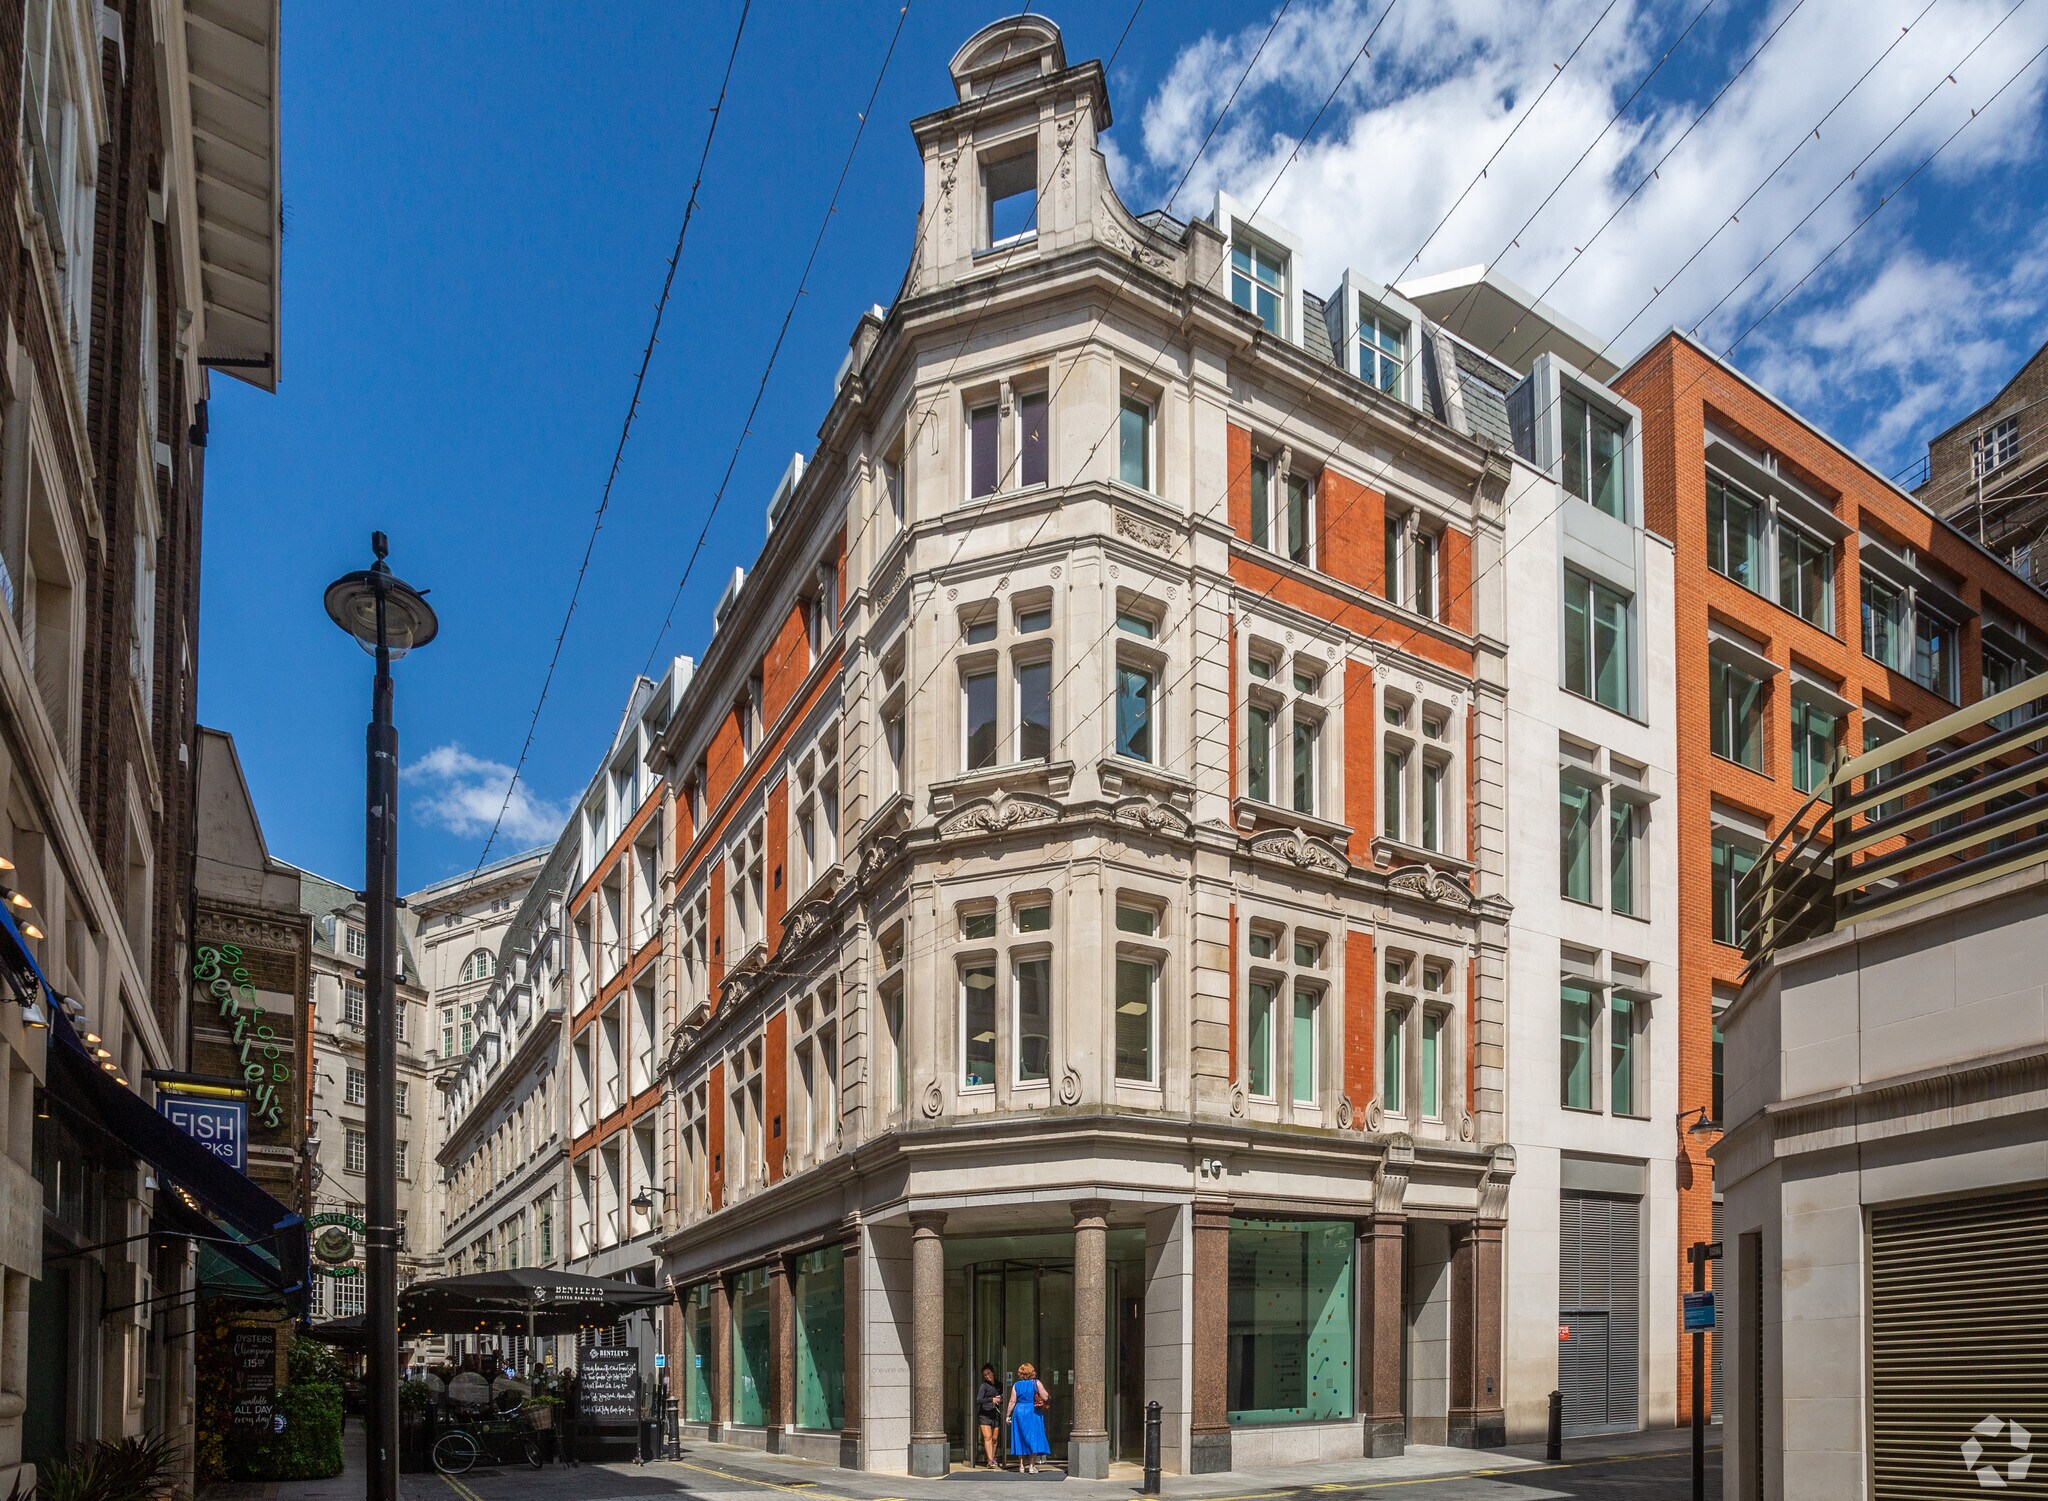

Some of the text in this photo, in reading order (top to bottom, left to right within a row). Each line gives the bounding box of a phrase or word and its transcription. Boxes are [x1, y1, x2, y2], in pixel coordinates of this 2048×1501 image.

[172, 1112, 234, 1141] FISH
[236, 1335, 273, 1343] OYSTERS
[599, 1349, 629, 1357] BENTLEY'S
[234, 1406, 273, 1414] ALL DAY
